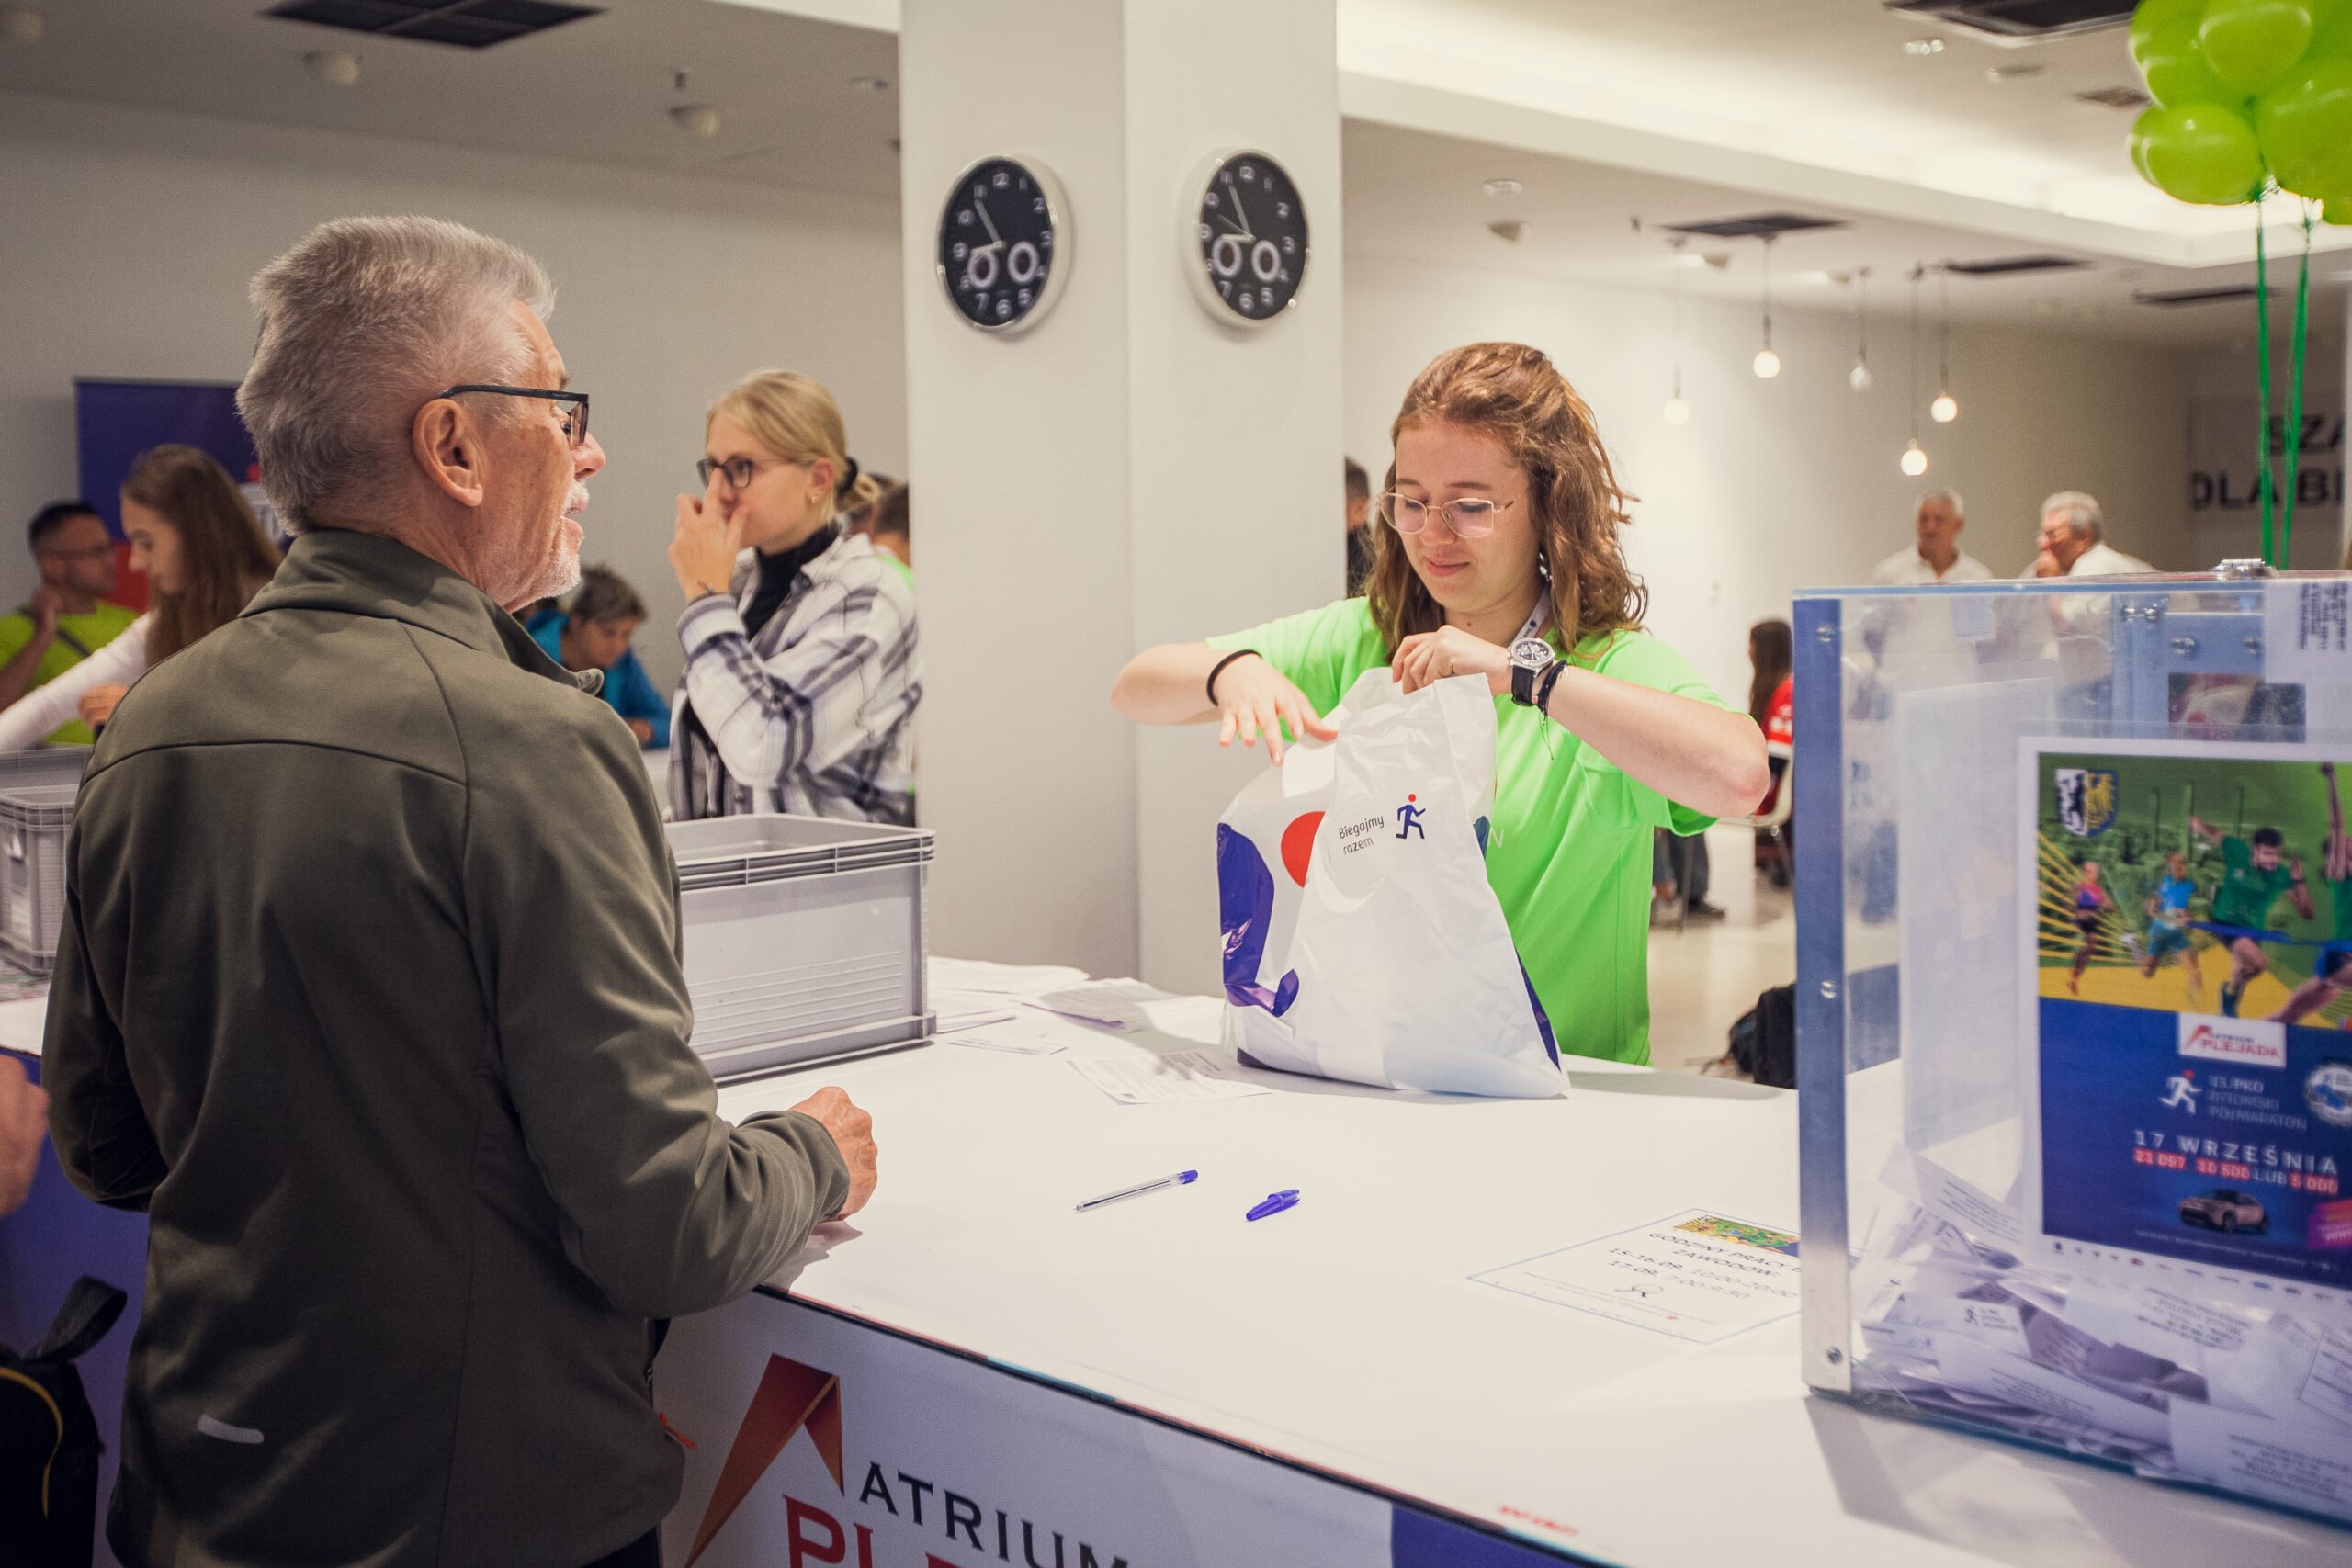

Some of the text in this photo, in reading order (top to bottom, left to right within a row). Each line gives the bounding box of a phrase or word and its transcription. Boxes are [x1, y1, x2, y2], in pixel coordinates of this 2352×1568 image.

[953, 242, 969, 262] 9
[1282, 235, 1296, 255] 3
[995, 299, 1013, 319] 6
[1238, 292, 1255, 314] 6
[2189, 470, 2280, 510] DLA
[1339, 816, 1385, 840] Biegajmy
[1343, 837, 1374, 855] razem
[2201, 1039, 2279, 1057] PLEJADA
[2133, 1131, 2338, 1176] 17 WRZEŚNIA
[2254, 1169, 2287, 1185] LUB
[1649, 1233, 1728, 1254] GODZINY
[1730, 1252, 1789, 1269] PRACY
